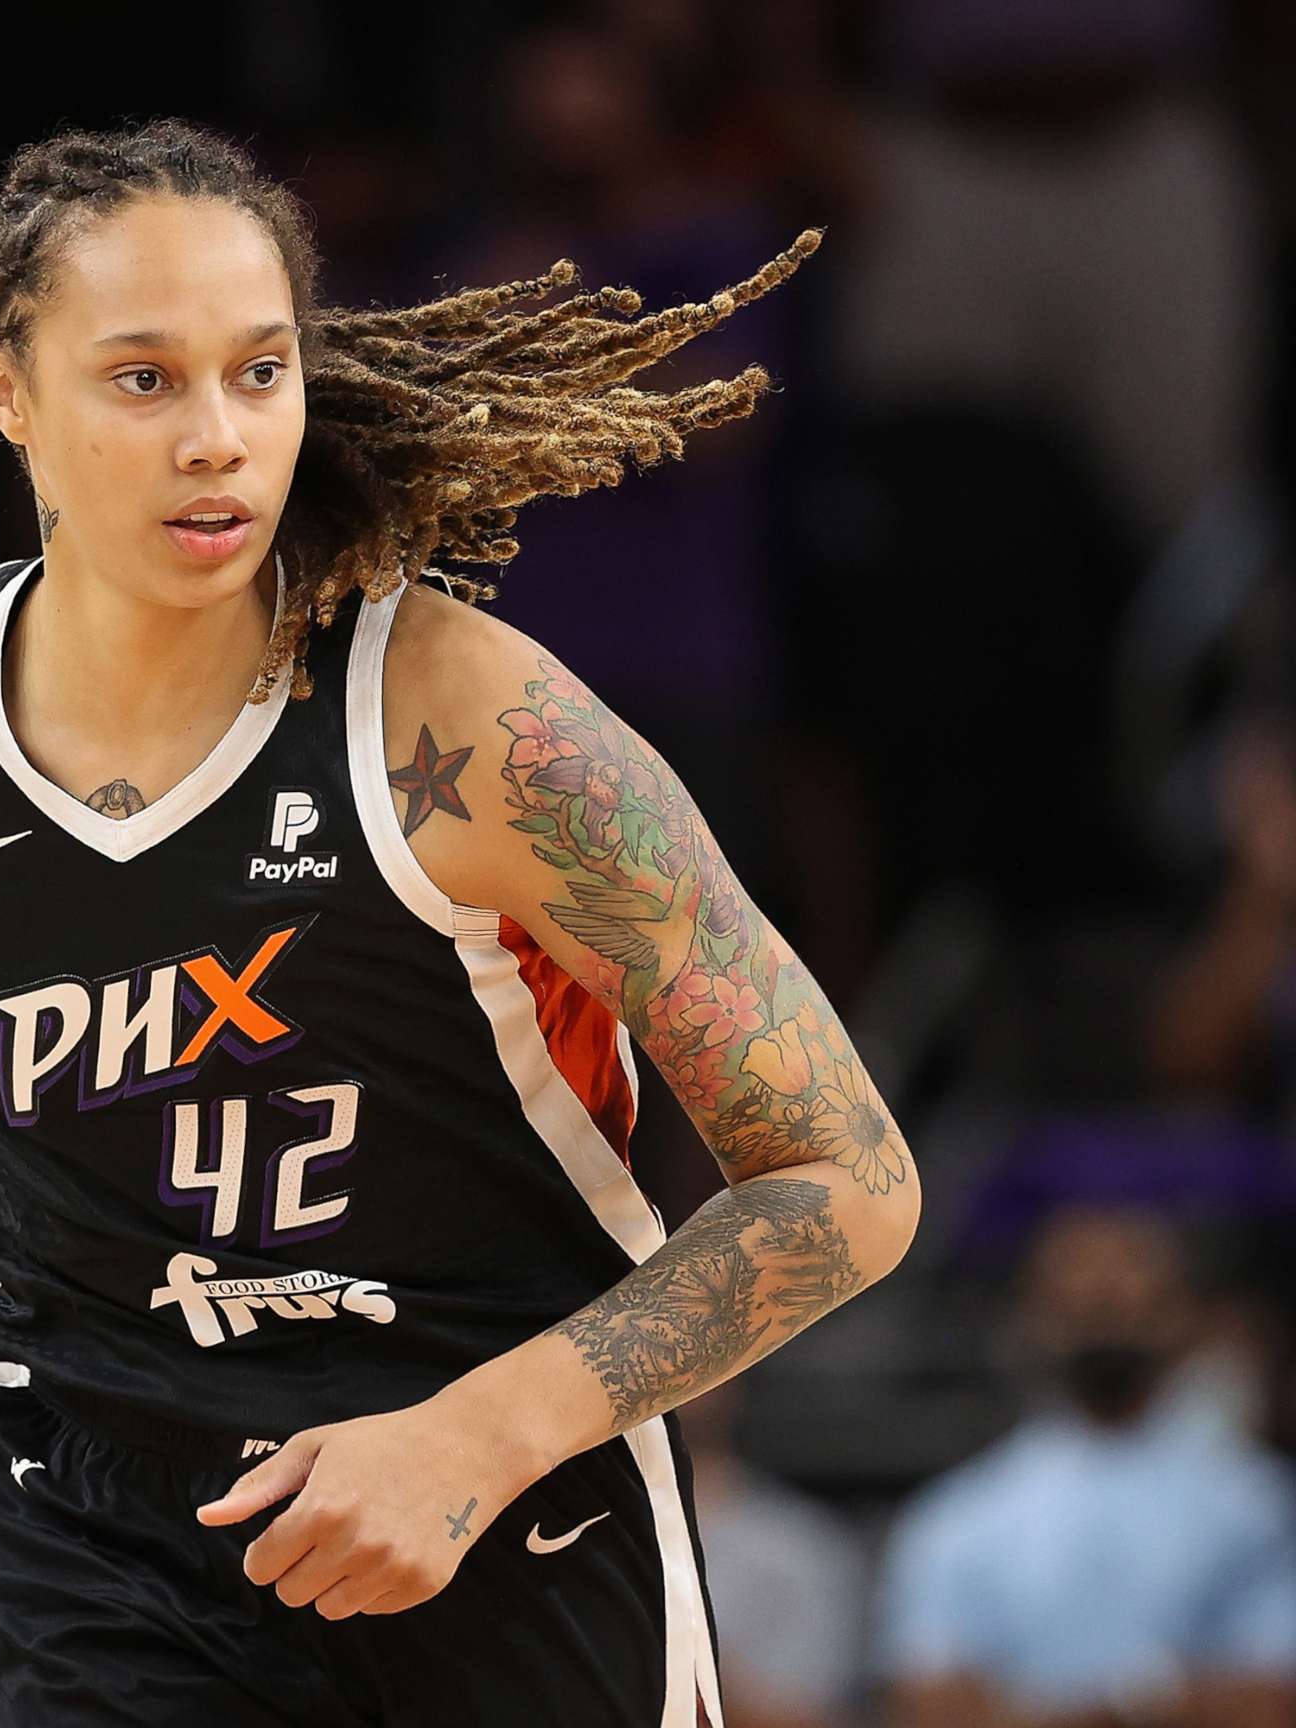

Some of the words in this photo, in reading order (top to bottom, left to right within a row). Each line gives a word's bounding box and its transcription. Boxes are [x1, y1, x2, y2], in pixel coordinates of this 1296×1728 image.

[249, 856, 338, 883] PayPal
[162, 1081, 361, 1244] 42
[205, 1280, 265, 1295] FOOD
